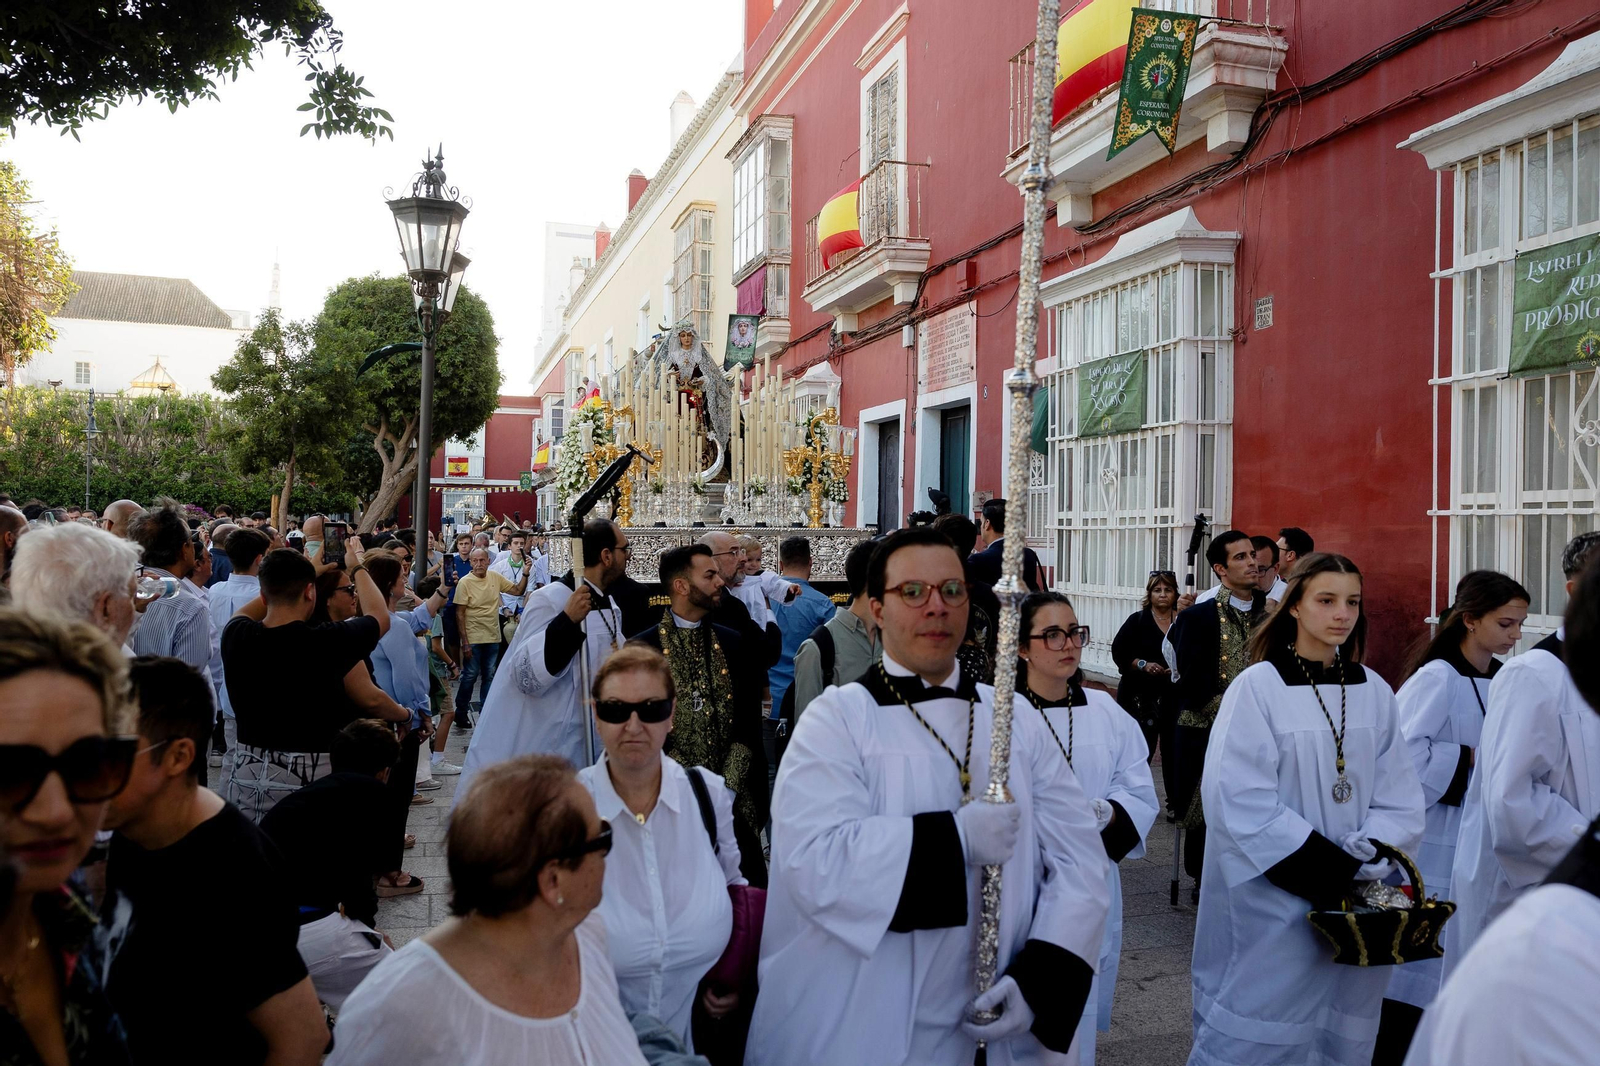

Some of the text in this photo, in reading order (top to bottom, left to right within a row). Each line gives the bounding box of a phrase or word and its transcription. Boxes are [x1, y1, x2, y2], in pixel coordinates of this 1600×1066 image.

[1136, 110, 1170, 118] CORONADA
[1139, 100, 1170, 109] ESPERANZA
[1526, 249, 1600, 283] ESTRELL
[1524, 296, 1600, 332] PRODIG
